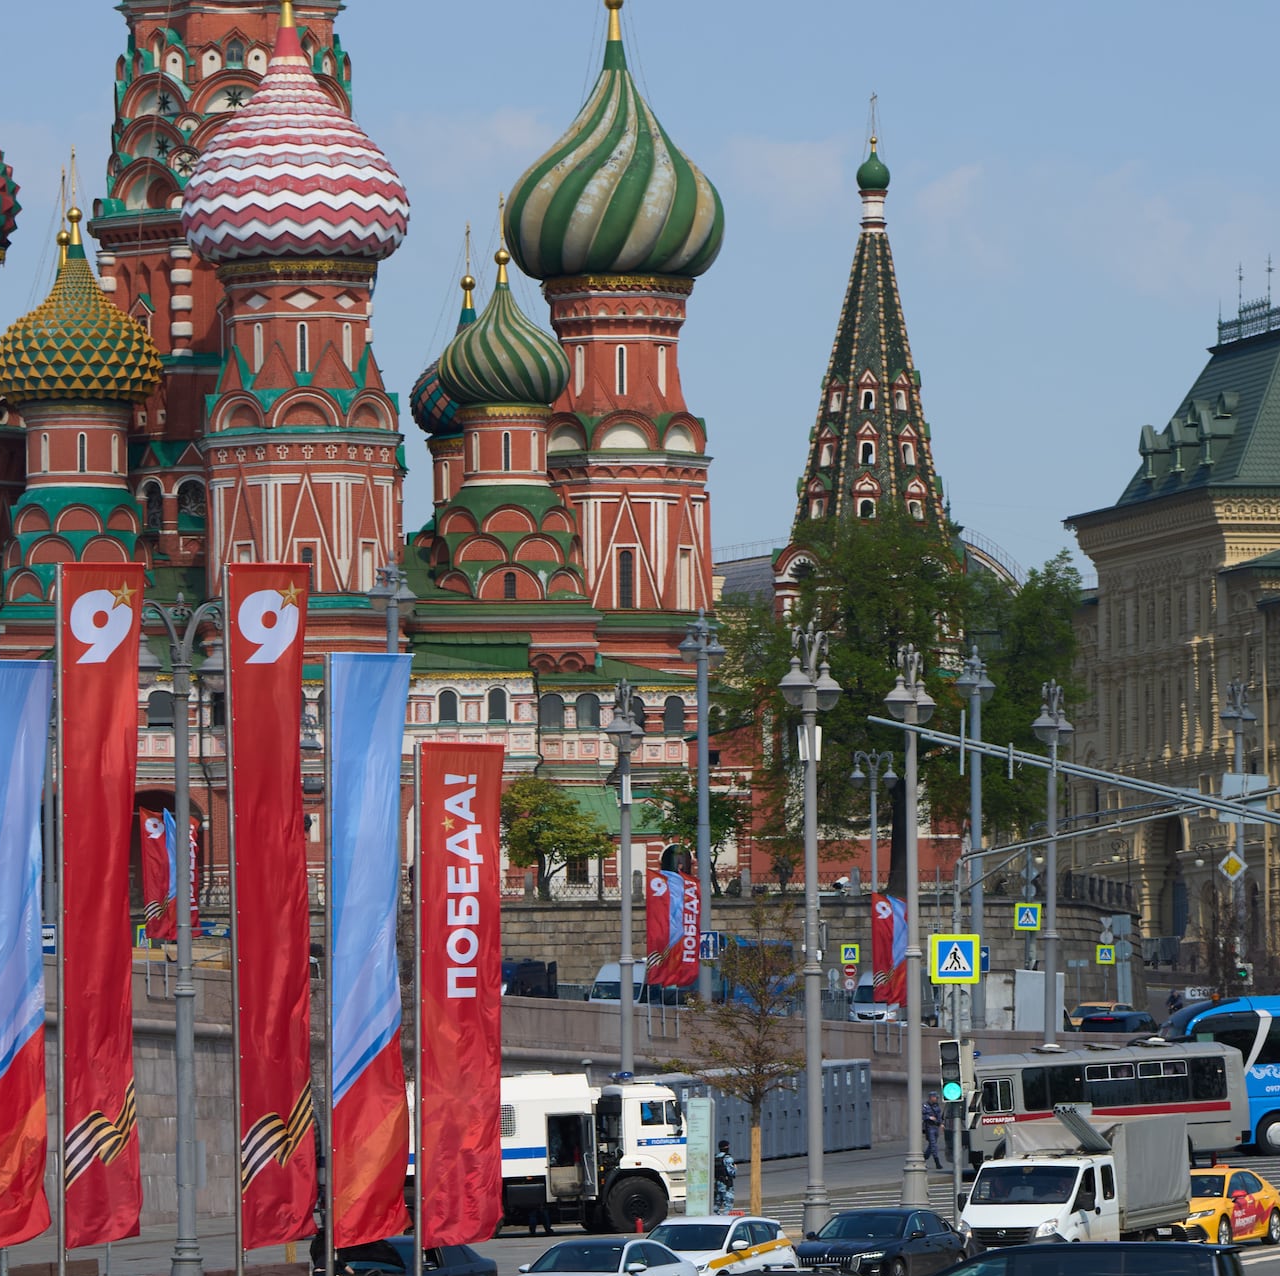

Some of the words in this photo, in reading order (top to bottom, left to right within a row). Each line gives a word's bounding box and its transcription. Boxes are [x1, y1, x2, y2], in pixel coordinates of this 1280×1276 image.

[70, 589, 134, 664] 9
[238, 589, 299, 664] 9
[145, 818, 165, 839] 9
[444, 773, 483, 999] ПОБЕДА!
[650, 877, 667, 897] 9
[683, 879, 700, 963] ПОБЕДА!
[875, 901, 892, 919] 9
